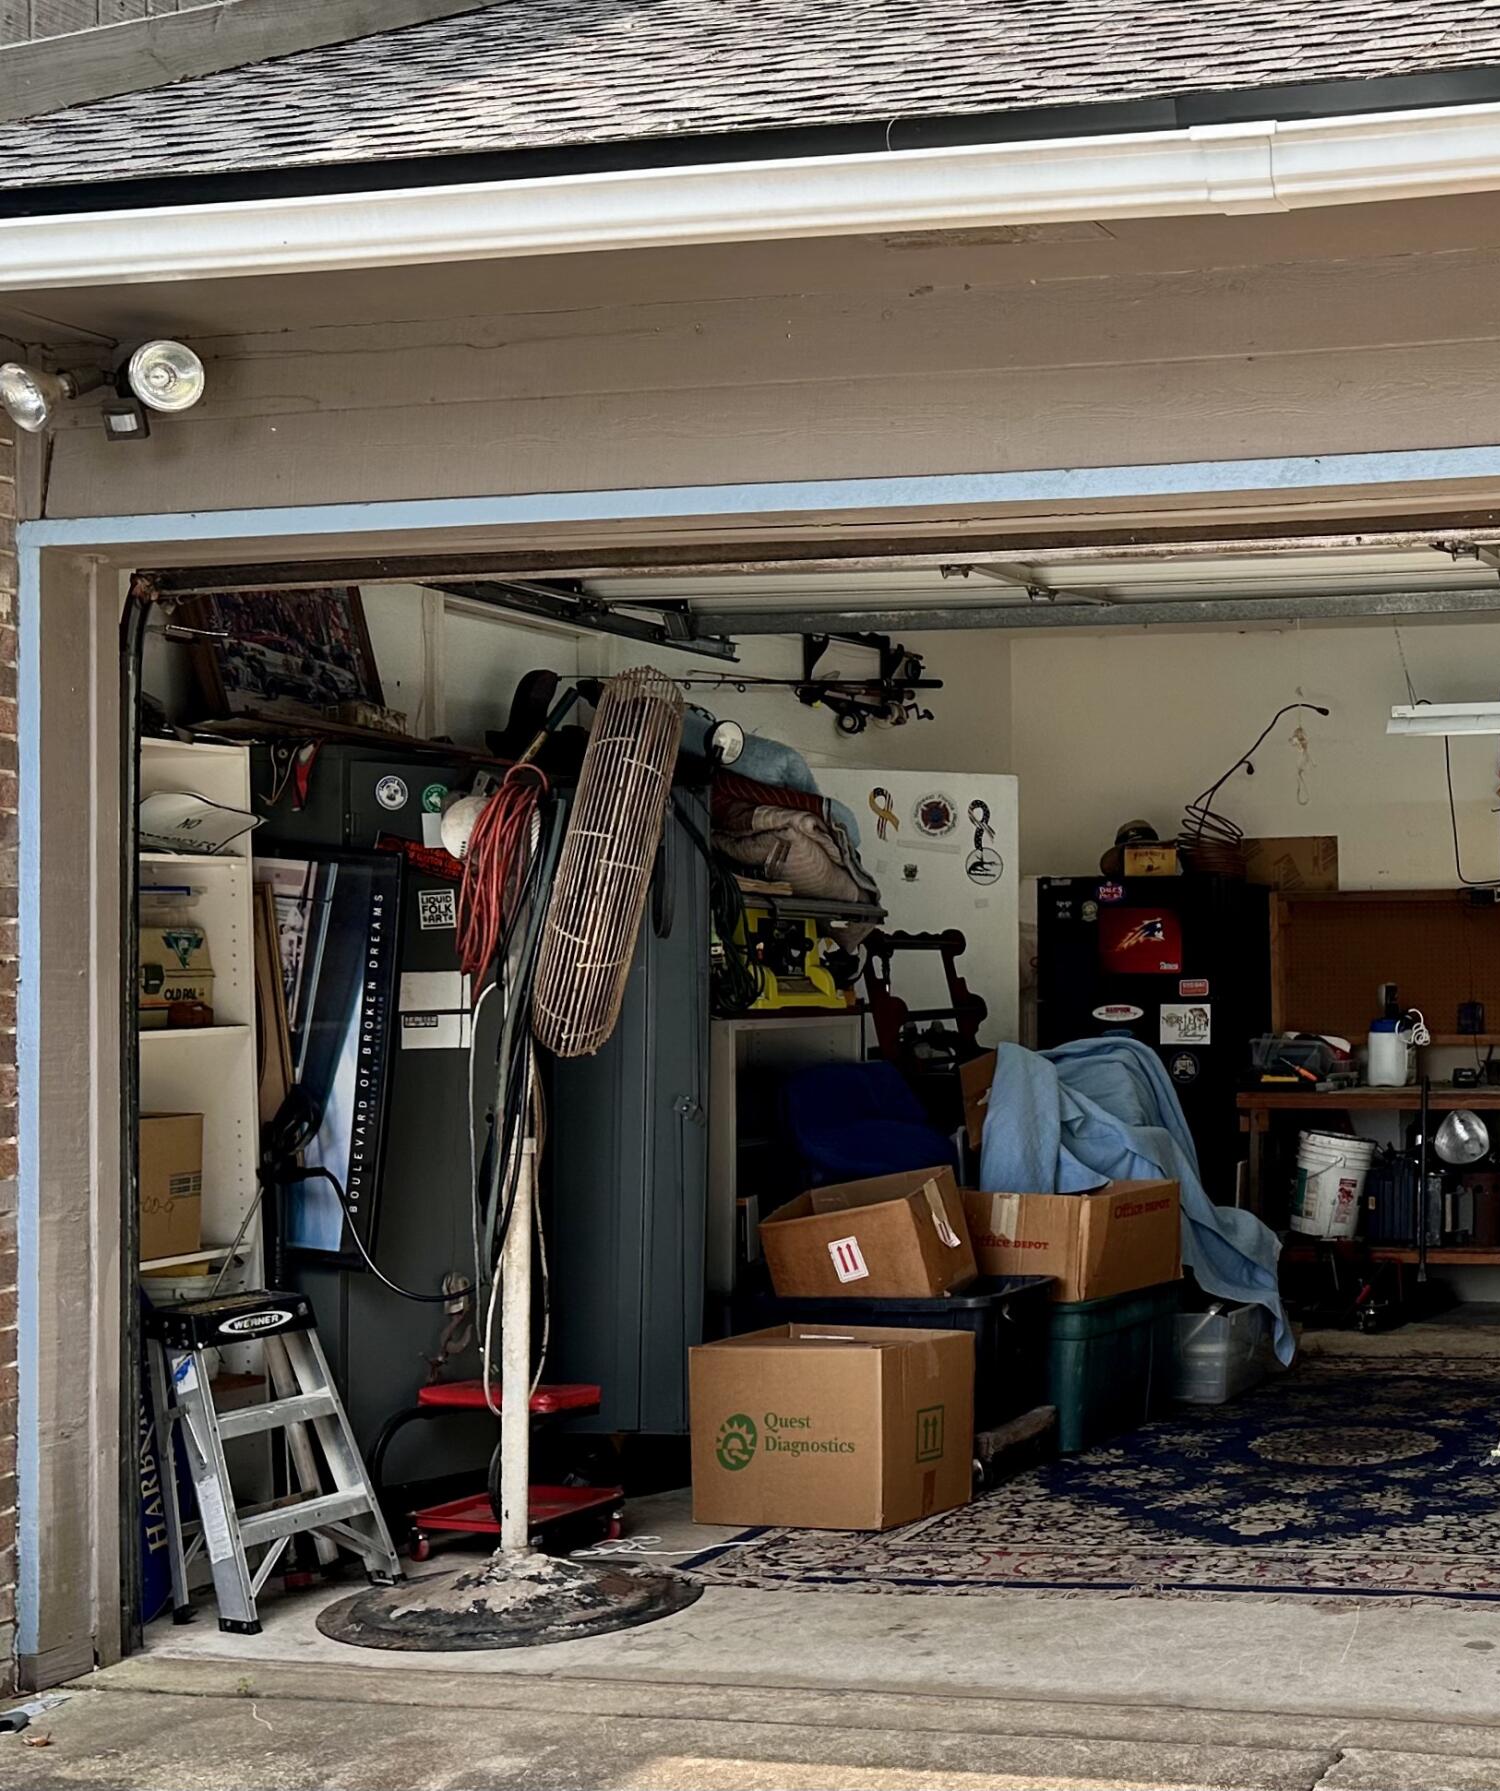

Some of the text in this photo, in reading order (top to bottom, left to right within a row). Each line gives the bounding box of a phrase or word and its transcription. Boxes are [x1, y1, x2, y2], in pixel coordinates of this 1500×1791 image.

[420, 895, 453, 906] LIQUID
[421, 904, 453, 915] FOLK
[428, 914, 449, 923] ART
[164, 988, 198, 1000] OLD PAL
[349, 894, 384, 1213] BOULEVARD OF BROKEN DREAMS
[1114, 1198, 1171, 1219] Office DEPOT
[1014, 1240, 1049, 1250] DEPOT
[233, 1313, 280, 1331] WERNER
[764, 1412, 812, 1433] Quest
[764, 1435, 856, 1457] Diagnostics
